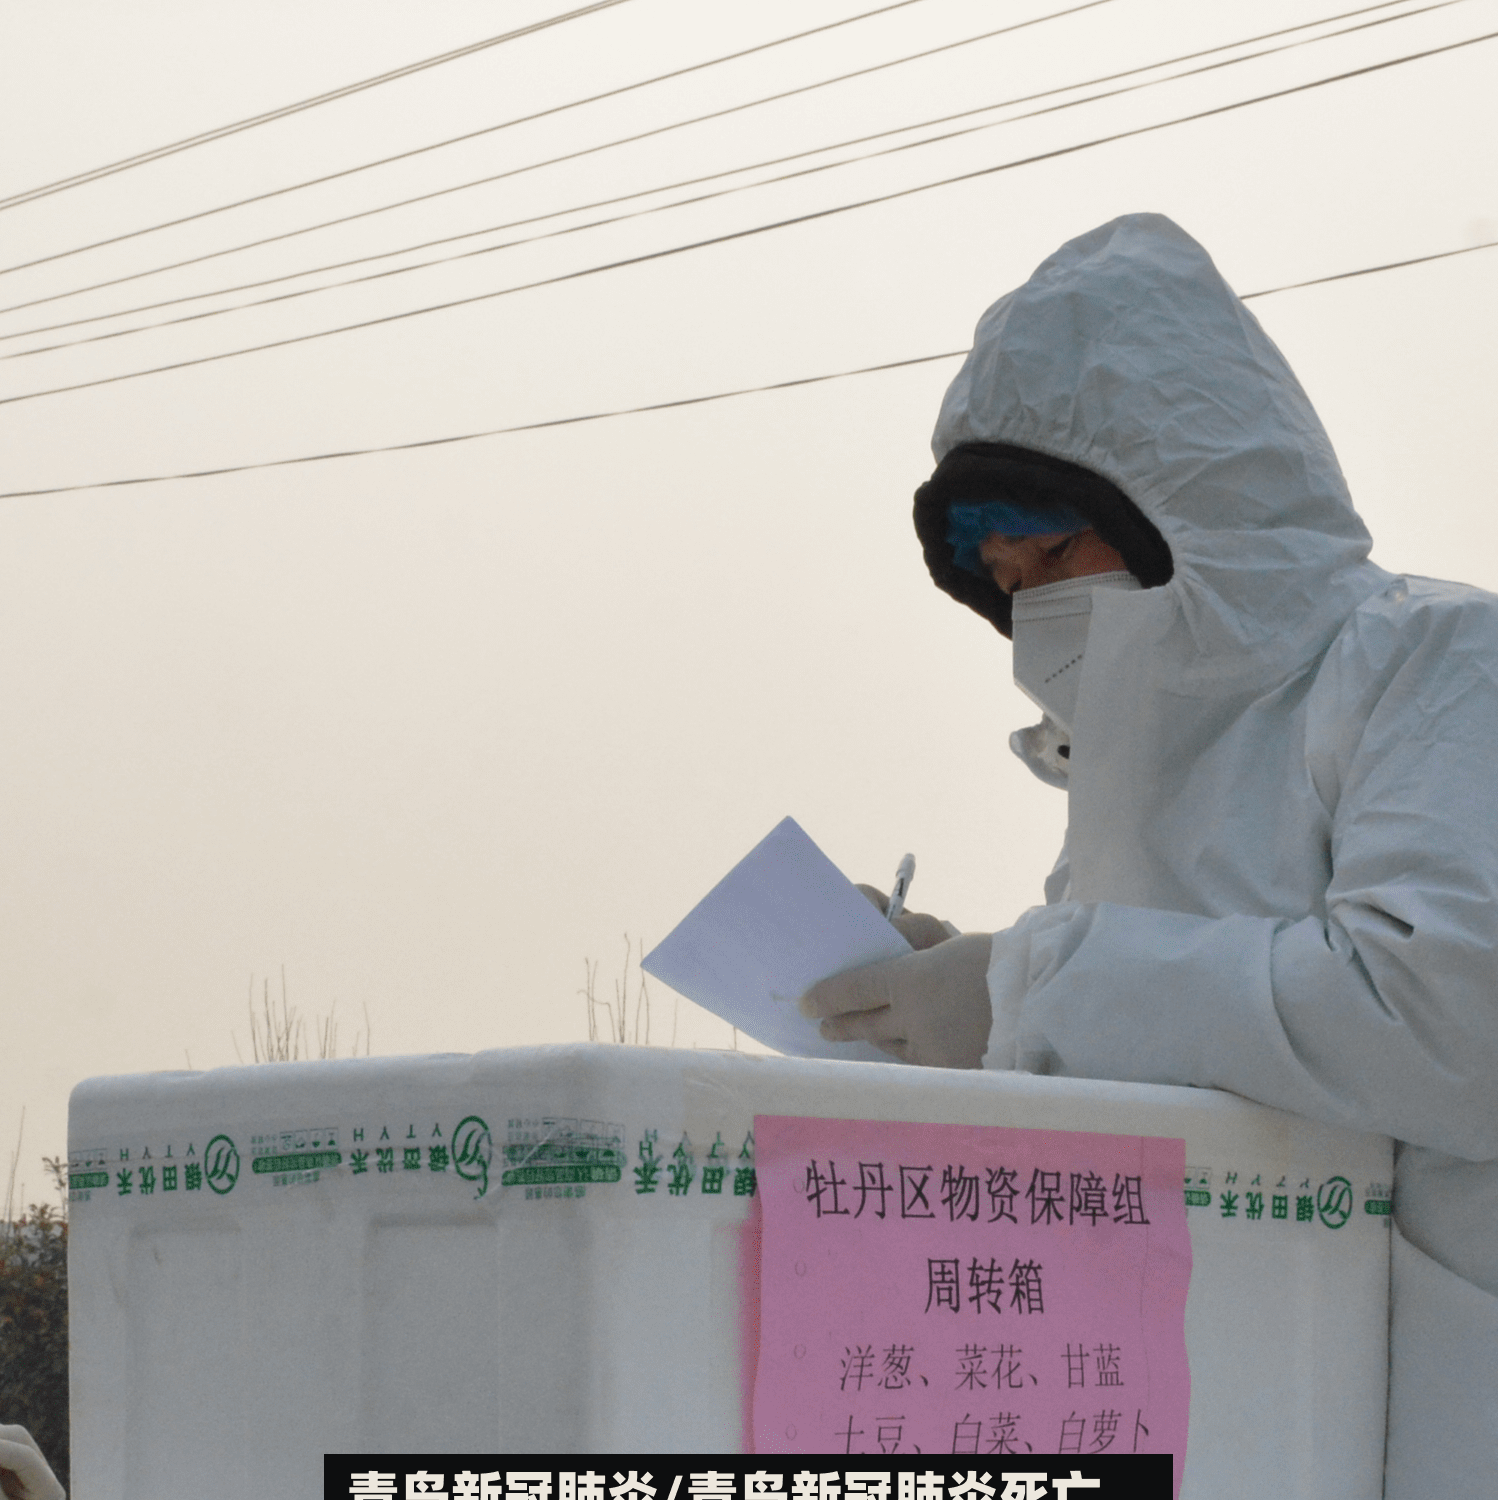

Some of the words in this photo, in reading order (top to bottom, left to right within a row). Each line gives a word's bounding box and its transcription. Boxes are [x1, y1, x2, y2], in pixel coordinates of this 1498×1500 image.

[116, 1162, 202, 1196] 银田优禾
[349, 1144, 449, 1175] 银田优禾
[805, 1159, 1151, 1228] 牡丹区物资保障组
[1220, 1190, 1315, 1223] 银田优禾
[924, 1257, 1046, 1314] 周转箱
[838, 1342, 1126, 1392] 洋葱、菜花、甘蓝
